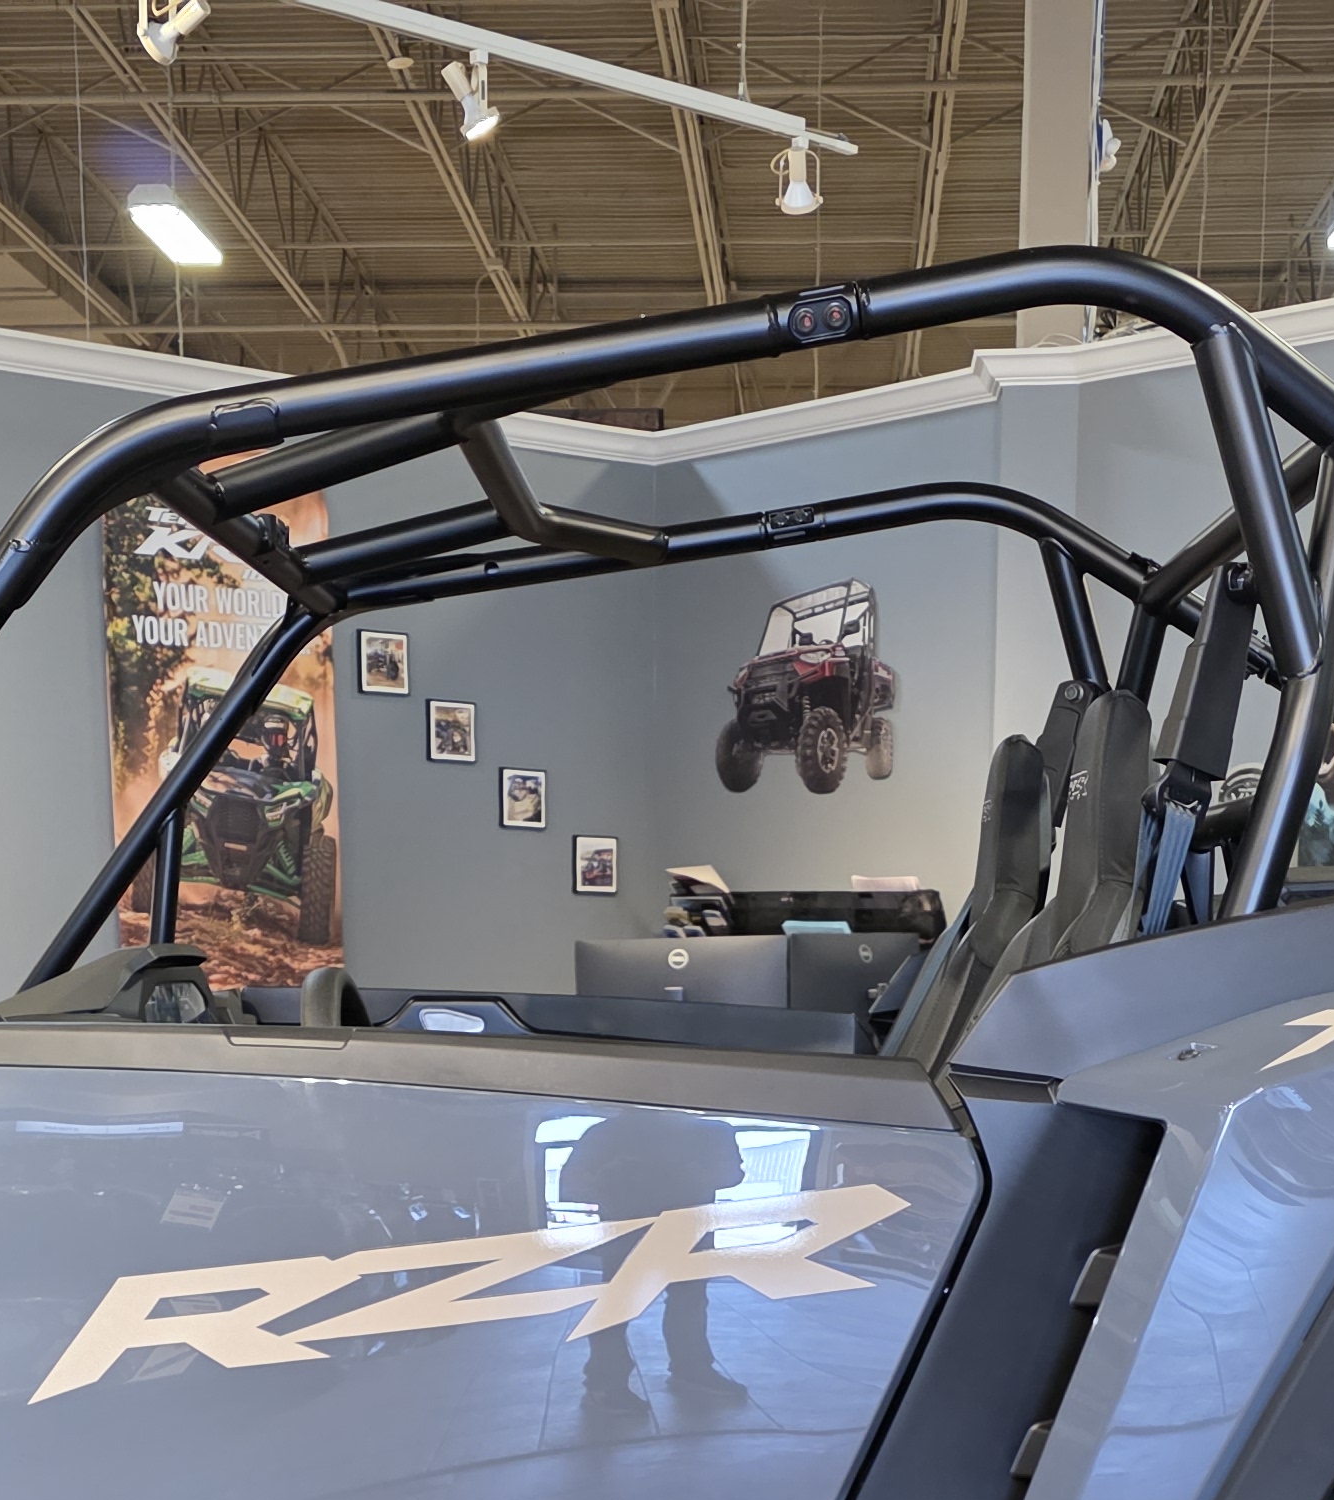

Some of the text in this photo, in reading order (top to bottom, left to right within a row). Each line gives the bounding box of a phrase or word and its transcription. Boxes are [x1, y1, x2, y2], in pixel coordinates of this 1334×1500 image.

[153, 581, 286, 617] YOUR WORLD
[132, 614, 189, 647] YOUR
[28, 1183, 911, 1405] RZR
